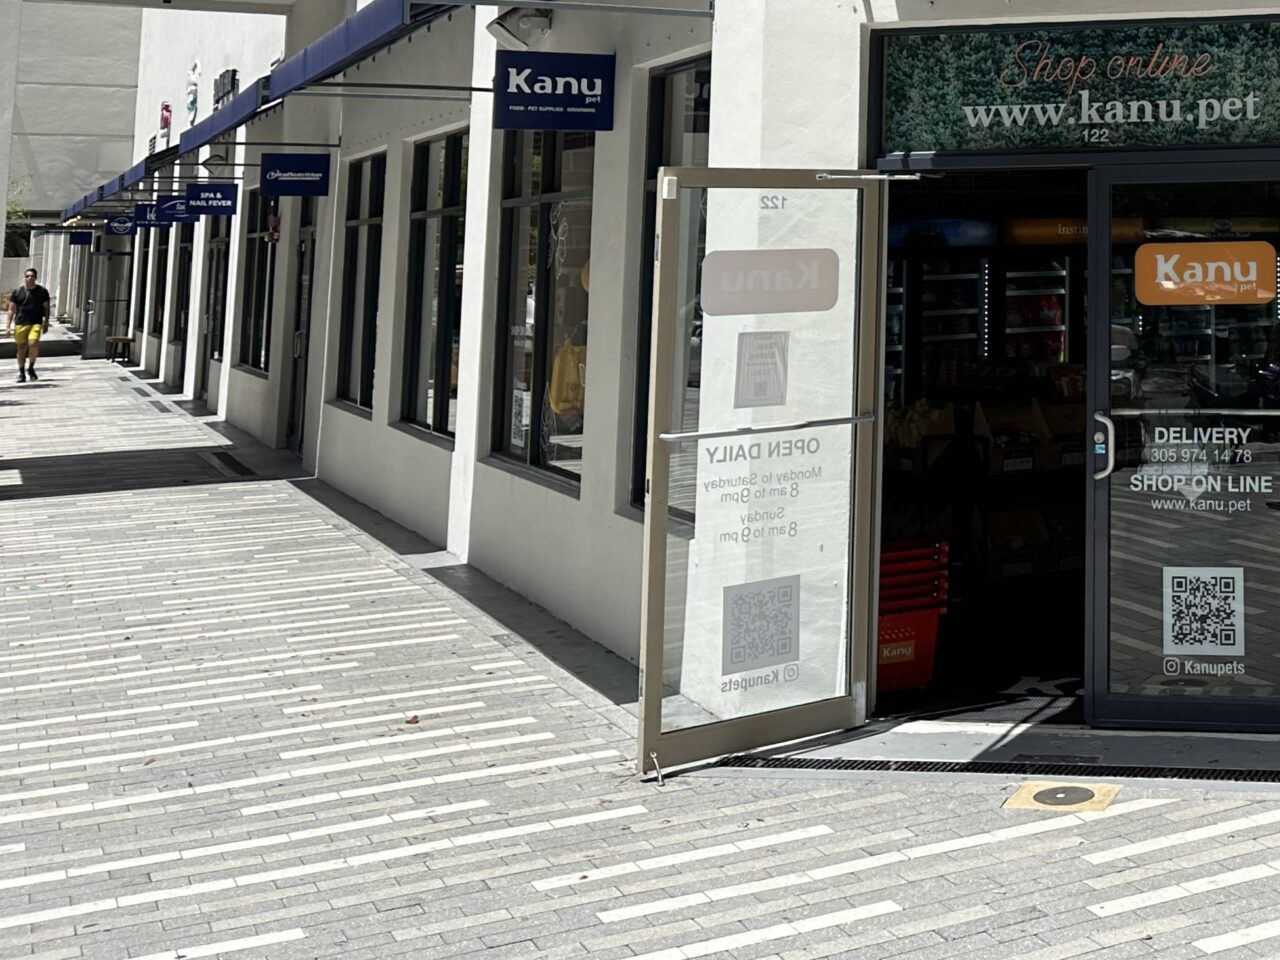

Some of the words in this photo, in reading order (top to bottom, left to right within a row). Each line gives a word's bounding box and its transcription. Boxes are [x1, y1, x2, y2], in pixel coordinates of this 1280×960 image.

[1000, 39, 1097, 94] Shop
[1106, 42, 1213, 80] online
[507, 68, 602, 95] Kanu
[585, 96, 601, 104] pet
[962, 89, 1261, 131] www.kanu.pet
[1082, 129, 1110, 142] 122
[1155, 253, 1257, 284] Kanu
[1240, 281, 1257, 294] pet
[1154, 427, 1252, 444] DELIVERY
[1150, 448, 1177, 462] 305
[1181, 449, 1208, 462] 974
[1130, 474, 1186, 492] SHOP
[1191, 475, 1221, 492] ON
[1228, 476, 1273, 493] LINE
[1151, 498, 1252, 514] www.kanu.pet
[883, 647, 912, 657] Kanu
[1184, 660, 1245, 676] Kanupets
